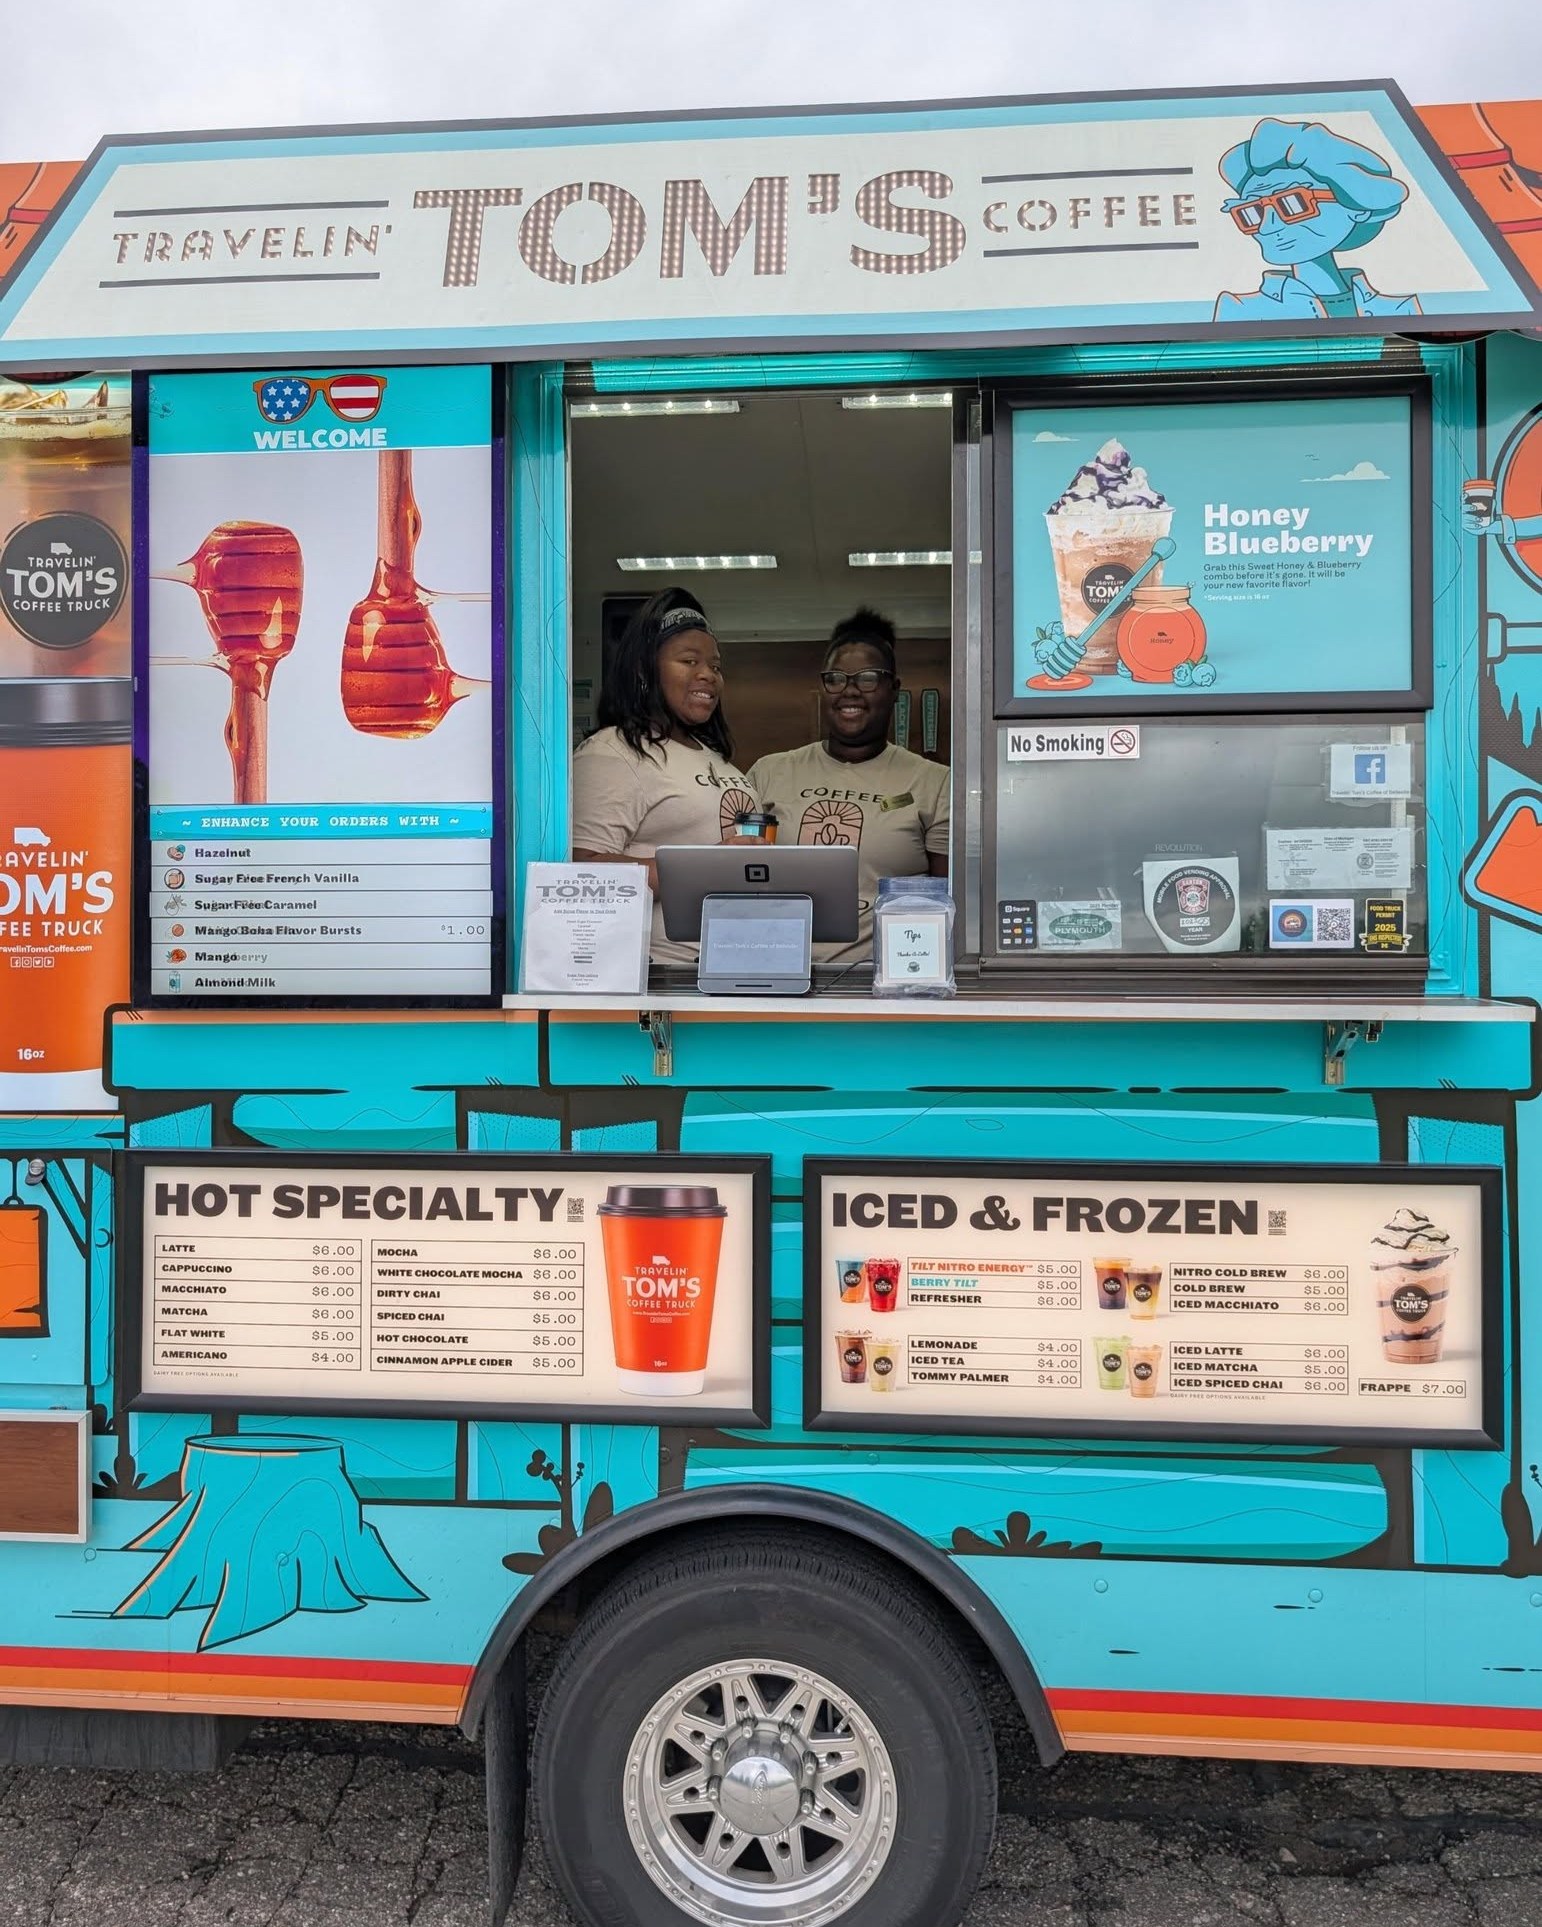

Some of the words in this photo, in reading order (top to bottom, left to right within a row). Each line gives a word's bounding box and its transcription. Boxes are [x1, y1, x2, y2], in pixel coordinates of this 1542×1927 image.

[112, 224, 392, 265] TRAVELIN'
[413, 169, 966, 287] TOM'S
[982, 193, 1197, 233] COFFEE
[254, 427, 387, 449] WELCOME
[1204, 503, 1310, 531] Honey
[1204, 530, 1374, 557] Blueberry
[28, 556, 96, 568] TRAVELIN'
[1203, 563, 1227, 571] Grab
[1228, 563, 1246, 571] this
[1247, 562, 1275, 571] Sweet
[1277, 562, 1304, 572] Honey
[1306, 561, 1315, 569] &
[1317, 561, 1362, 571] Blueberry
[1203, 572, 1234, 580] combo
[1236, 571, 1265, 579] before
[1266, 571, 1280, 579] it's
[1282, 572, 1306, 581] gone.
[1308, 570, 1315, 578] It
[1316, 570, 1332, 578] will
[6, 567, 118, 598] TOM'S
[1203, 582, 1224, 591] your
[1245, 580, 1280, 589] favorite
[1282, 580, 1311, 588] flavor!
[13, 600, 61, 612] COFFEE
[67, 598, 110, 612] TRUCK
[1011, 735, 1031, 752] No
[1036, 733, 1105, 755] Smoking
[800, 787, 884, 804] COFFEE
[201, 816, 270, 828] ENHANCE
[279, 816, 319, 827] YOUR
[329, 815, 389, 827] ORDERS
[399, 815, 440, 826] WITH
[0, 850, 89, 868] AVELIN'
[195, 848, 251, 858] Hazelnut
[195, 873, 234, 885] Sugar
[266, 873, 311, 884] French
[314, 873, 360, 883] Vanilla
[536, 885, 638, 898] TOM'S
[194, 900, 232, 912] Sugar
[264, 900, 317, 910] Caramel
[41, 919, 103, 937] TRUCK
[195, 925, 238, 937] Mango
[275, 925, 317, 935] Flavor
[320, 925, 362, 935] Bursts
[440, 924, 485, 935] $1.00
[1055, 926, 1106, 935] PLYMOUTH
[1374, 923, 1397, 932] 2025
[904, 929, 922, 943] Tips
[195, 952, 238, 963] Mango
[195, 977, 244, 987] Almond
[248, 977, 276, 987] Milk
[155, 1183, 262, 1218] HOT
[272, 1184, 565, 1222] SPECIALTY
[832, 1192, 958, 1229] ICED
[969, 1195, 1021, 1231] &
[1033, 1197, 1258, 1235] FROZEN
[162, 1244, 196, 1253] LATTE
[312, 1245, 355, 1257] $6.00
[377, 1248, 418, 1257] MOCHA
[533, 1249, 577, 1260] $6.00
[162, 1264, 233, 1274] CAPPUCCINO
[312, 1265, 355, 1277] $6.00
[377, 1268, 413, 1278] WHITE
[415, 1269, 480, 1279] CHOCOLATE
[482, 1270, 523, 1279] MOCHA
[533, 1269, 577, 1281] $6.00
[634, 1266, 689, 1276] TRAVELIN'
[911, 1262, 936, 1271] TILT
[938, 1263, 976, 1272] NITRO
[1037, 1264, 1078, 1274] $5.00
[1174, 1268, 1212, 1277] NITRO
[1215, 1268, 1248, 1278] COLD
[1250, 1269, 1287, 1278] BREW
[1304, 1269, 1345, 1280] $6.00
[622, 1276, 701, 1298] TOM'S
[911, 1278, 951, 1287] BERRY
[953, 1279, 979, 1288] TILT
[1037, 1280, 1078, 1290] $5.00
[1174, 1284, 1207, 1293] COLD
[1209, 1284, 1246, 1294] BREW
[1304, 1285, 1345, 1296] $5.00
[161, 1285, 227, 1294] MACCHIATO
[312, 1286, 354, 1297] $6.00
[377, 1290, 410, 1298] DIRTY
[413, 1290, 441, 1299] CHAI
[533, 1290, 576, 1302] $6.00
[626, 1299, 661, 1308] COFFEE
[665, 1299, 696, 1309] TRUCK
[911, 1294, 982, 1304] REFRESHER
[1037, 1296, 1078, 1306] $6.00
[1174, 1300, 1202, 1309] ICED
[1204, 1301, 1280, 1310] MACCHIATO
[1304, 1301, 1345, 1312] $6.00
[1394, 1299, 1429, 1309] TOM'S
[161, 1307, 208, 1316] MATCHA
[312, 1309, 354, 1320] $6.00
[377, 1312, 416, 1321] SPICED
[418, 1313, 445, 1321] CHAI
[533, 1313, 576, 1325] $5.00
[161, 1329, 187, 1338] FLAT
[190, 1329, 226, 1338] WHITE
[312, 1331, 354, 1342] $5.00
[376, 1334, 399, 1342] HOT
[402, 1335, 469, 1344] CHOCOLATE
[533, 1336, 576, 1347] $5.00
[911, 1340, 978, 1350] LEMONADE
[1037, 1342, 1078, 1353] $4.00
[1174, 1346, 1202, 1355] ICED
[1205, 1346, 1243, 1356] LATTE
[1304, 1348, 1345, 1359] $6.00
[161, 1350, 228, 1360] AMERICANO
[312, 1352, 354, 1363] $4.00
[376, 1355, 439, 1365] CINNAMON
[441, 1357, 477, 1366] APPLE
[480, 1358, 513, 1367] CIDER
[533, 1358, 576, 1369] $5.00
[911, 1355, 939, 1365] ICED
[941, 1356, 965, 1366] TEA
[1037, 1358, 1078, 1369] $4.00
[1174, 1362, 1203, 1371] ICED
[1205, 1363, 1258, 1372] MATCHA
[1304, 1364, 1346, 1375] $5.00
[911, 1372, 957, 1381] TOMMY
[960, 1373, 1009, 1382] PALMER
[1037, 1374, 1078, 1385] $4.00
[1174, 1378, 1203, 1387] ICED
[1205, 1379, 1251, 1388] SPICED
[1252, 1380, 1283, 1389] CHAI
[1304, 1381, 1346, 1392] $6.00
[1361, 1383, 1411, 1393] FRAPPE
[1422, 1383, 1464, 1395] $7.00
